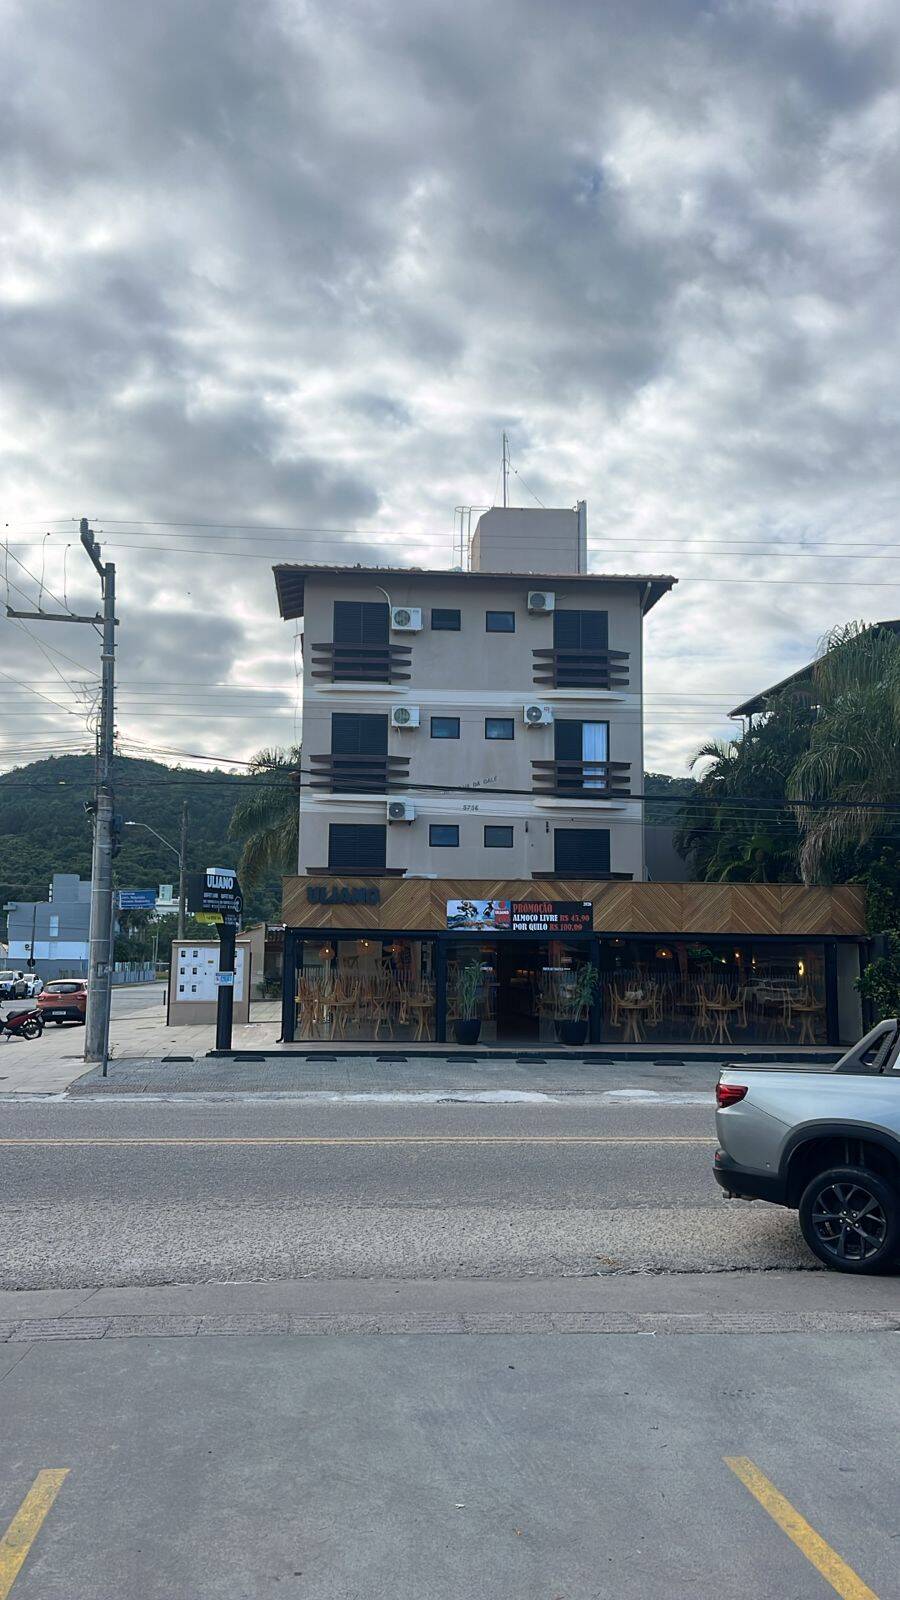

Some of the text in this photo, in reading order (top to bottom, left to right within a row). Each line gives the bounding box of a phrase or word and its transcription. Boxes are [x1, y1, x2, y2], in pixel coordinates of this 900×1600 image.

[207, 874, 234, 890] ULIANO
[306, 886, 380, 906] ULIANO
[512, 902, 553, 914] PROMOÇÃO
[512, 914, 539, 922] ALMOÇO
[540, 914, 559, 922] LIVRE
[512, 923, 527, 931] POR
[529, 923, 548, 931] QUILO
